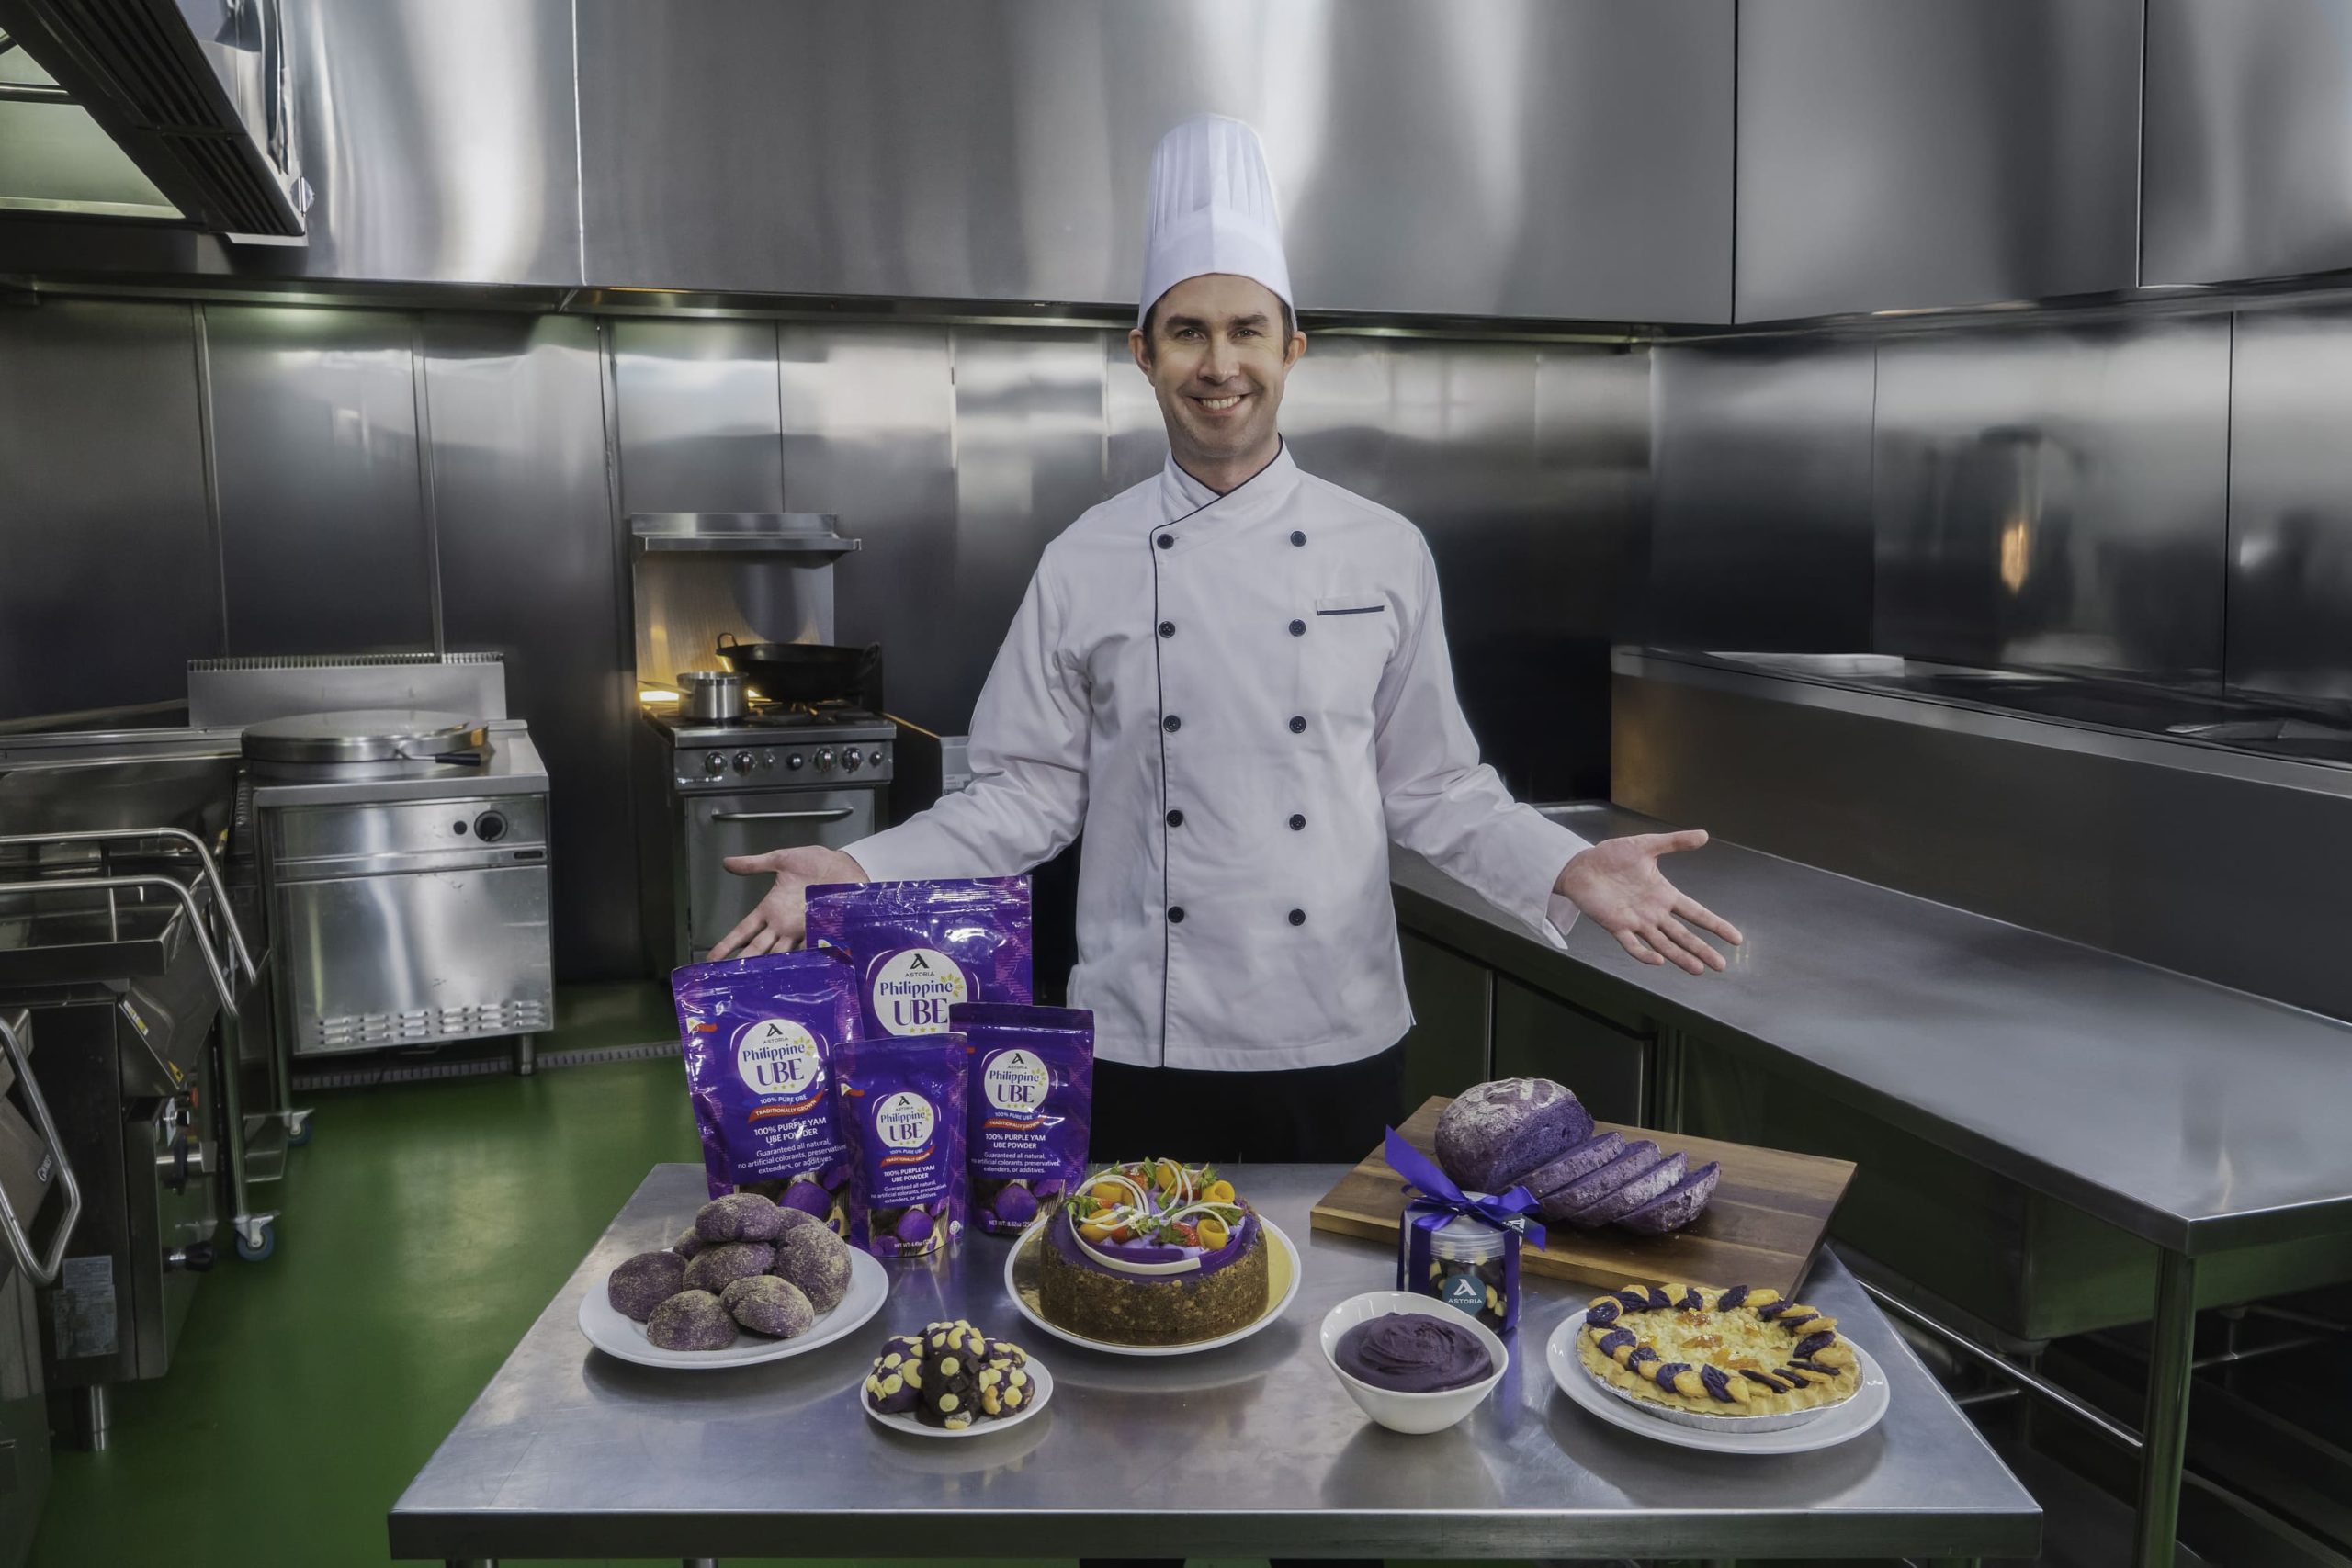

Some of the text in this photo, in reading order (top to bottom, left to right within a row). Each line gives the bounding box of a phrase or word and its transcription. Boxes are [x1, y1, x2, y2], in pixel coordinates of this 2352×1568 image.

[880, 980, 953, 998] Philippine
[894, 998, 948, 1026] UBE
[742, 1043, 805, 1062] Philippine
[756, 1058, 805, 1086] UBE
[989, 1070, 1039, 1084] Philippine
[796, 1094, 808, 1102] UBE
[997, 1084, 1035, 1103] UBE
[755, 1100, 817, 1116] TRADITIONALLY GROWN
[881, 1111, 925, 1123] Philippine
[754, 1117, 827, 1136] 100% PURPLE YAM
[889, 1122, 922, 1142] UBE
[756, 1139, 831, 1157] Guaranteed all natural,
[765, 1134, 782, 1144] UBE
[747, 1156, 775, 1168] artificial
[775, 1152, 807, 1163] colorants,
[758, 1163, 793, 1174] extenders,
[803, 1156, 833, 1166] additives.
[903, 1173, 929, 1181] POWDER
[884, 1184, 912, 1192] Guaranteed
